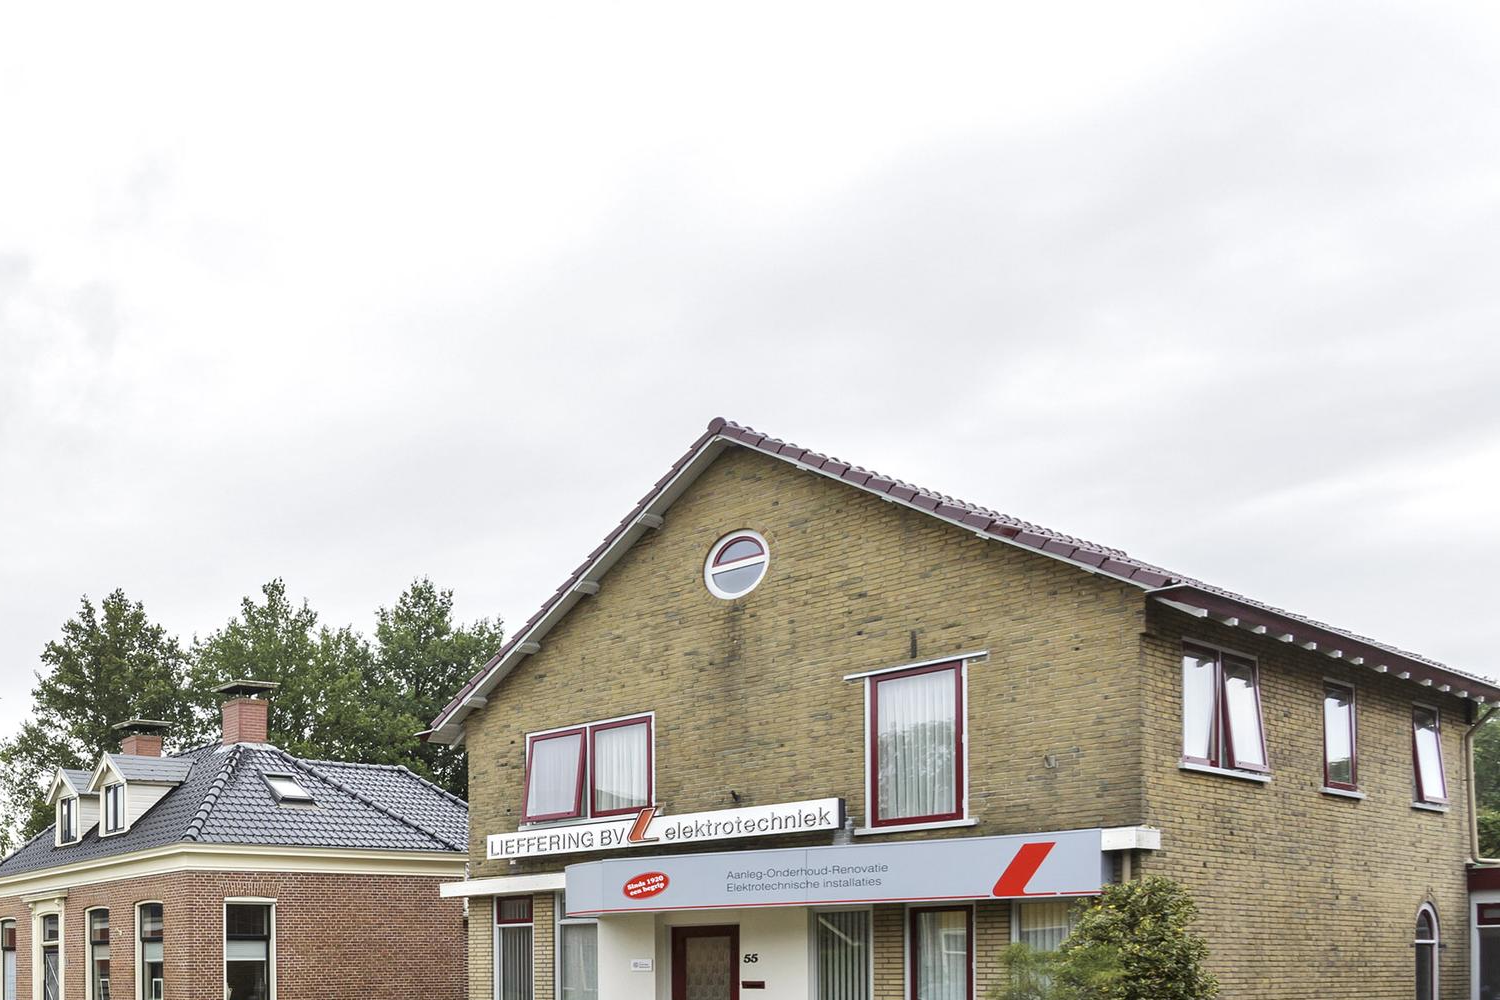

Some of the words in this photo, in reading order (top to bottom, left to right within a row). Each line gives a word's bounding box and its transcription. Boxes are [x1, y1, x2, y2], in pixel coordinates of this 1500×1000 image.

[490, 831, 594, 856] LIEFFERING
[601, 827, 625, 847] BV
[665, 807, 831, 840] elektrotechniek
[726, 863, 889, 880] Aanleg-Onderhoud-Renovatie
[627, 881, 646, 890] Sinds
[647, 875, 664, 885] 1920
[642, 882, 665, 892] begrip
[726, 878, 820, 892] Elektrotechnische
[823, 877, 882, 888] installaties
[743, 953, 759, 964] 55
